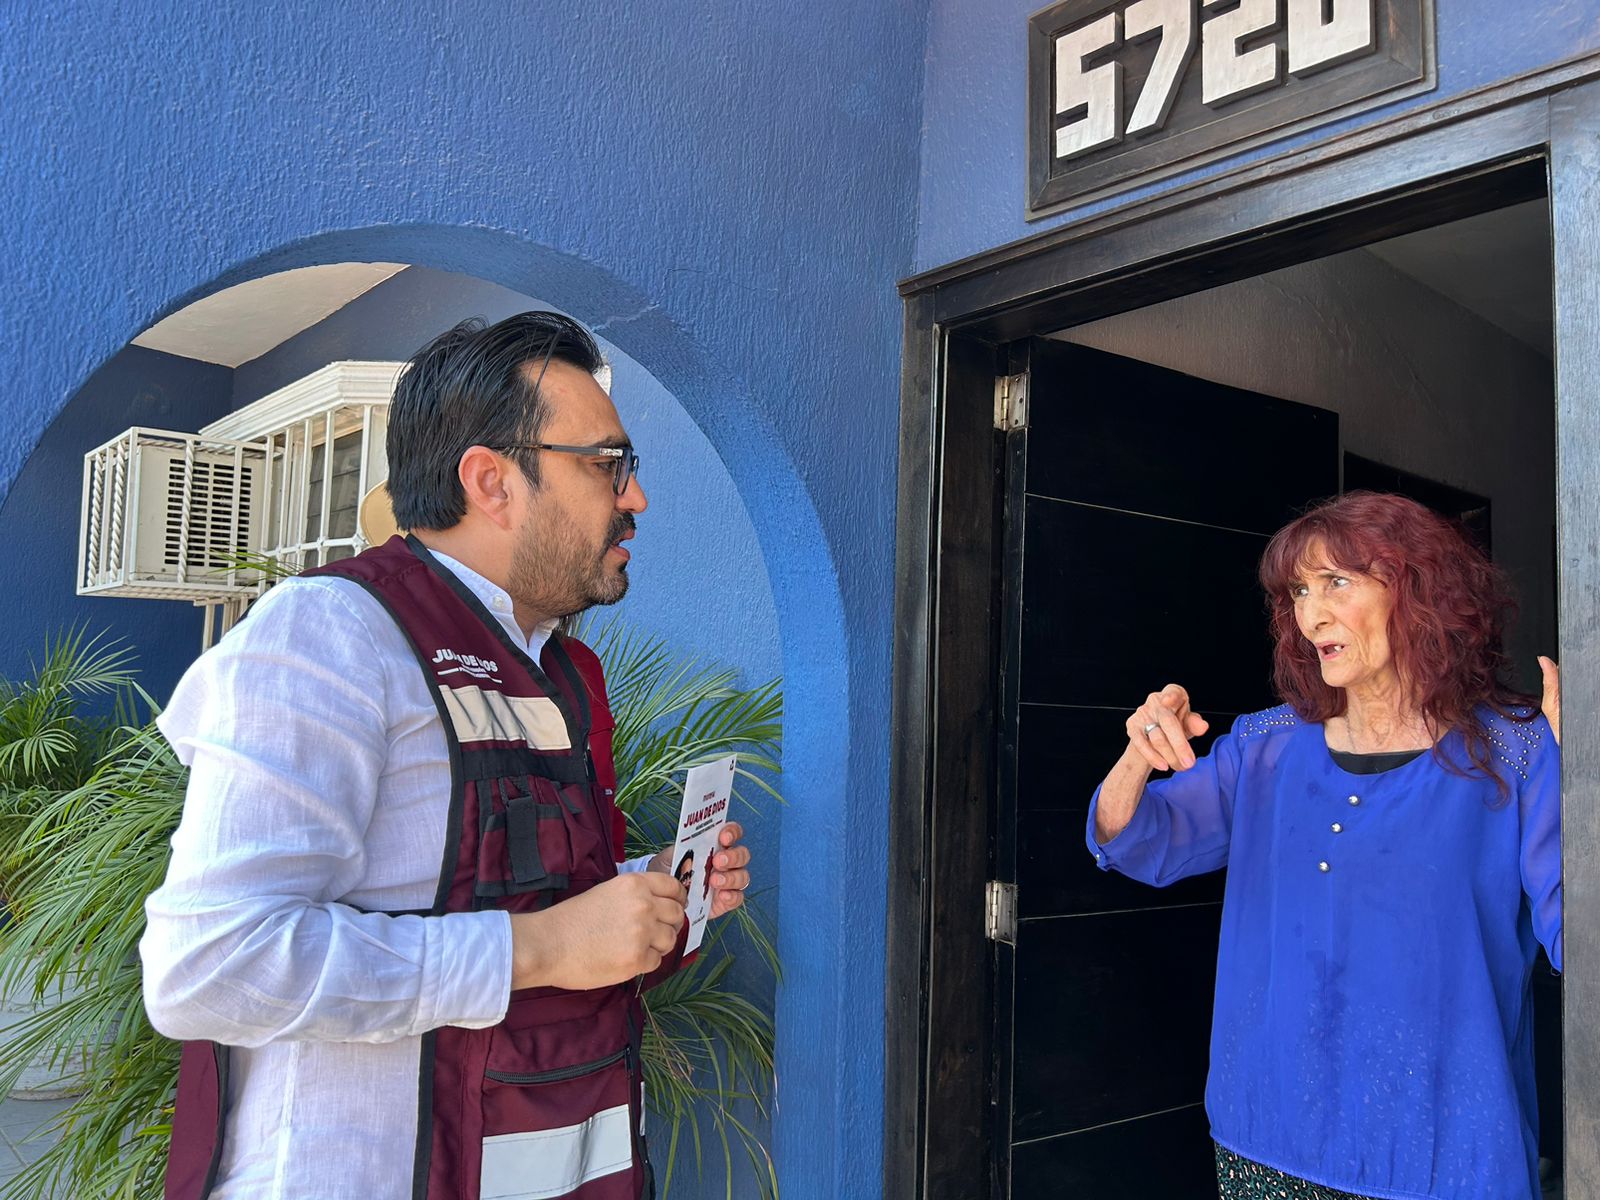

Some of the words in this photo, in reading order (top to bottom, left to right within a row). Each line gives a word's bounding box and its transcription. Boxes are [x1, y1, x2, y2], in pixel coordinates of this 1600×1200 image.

[461, 654, 478, 667] DE
[684, 809, 703, 828] JUAN
[703, 805, 712, 819] DE
[712, 798, 726, 815] DIOS
